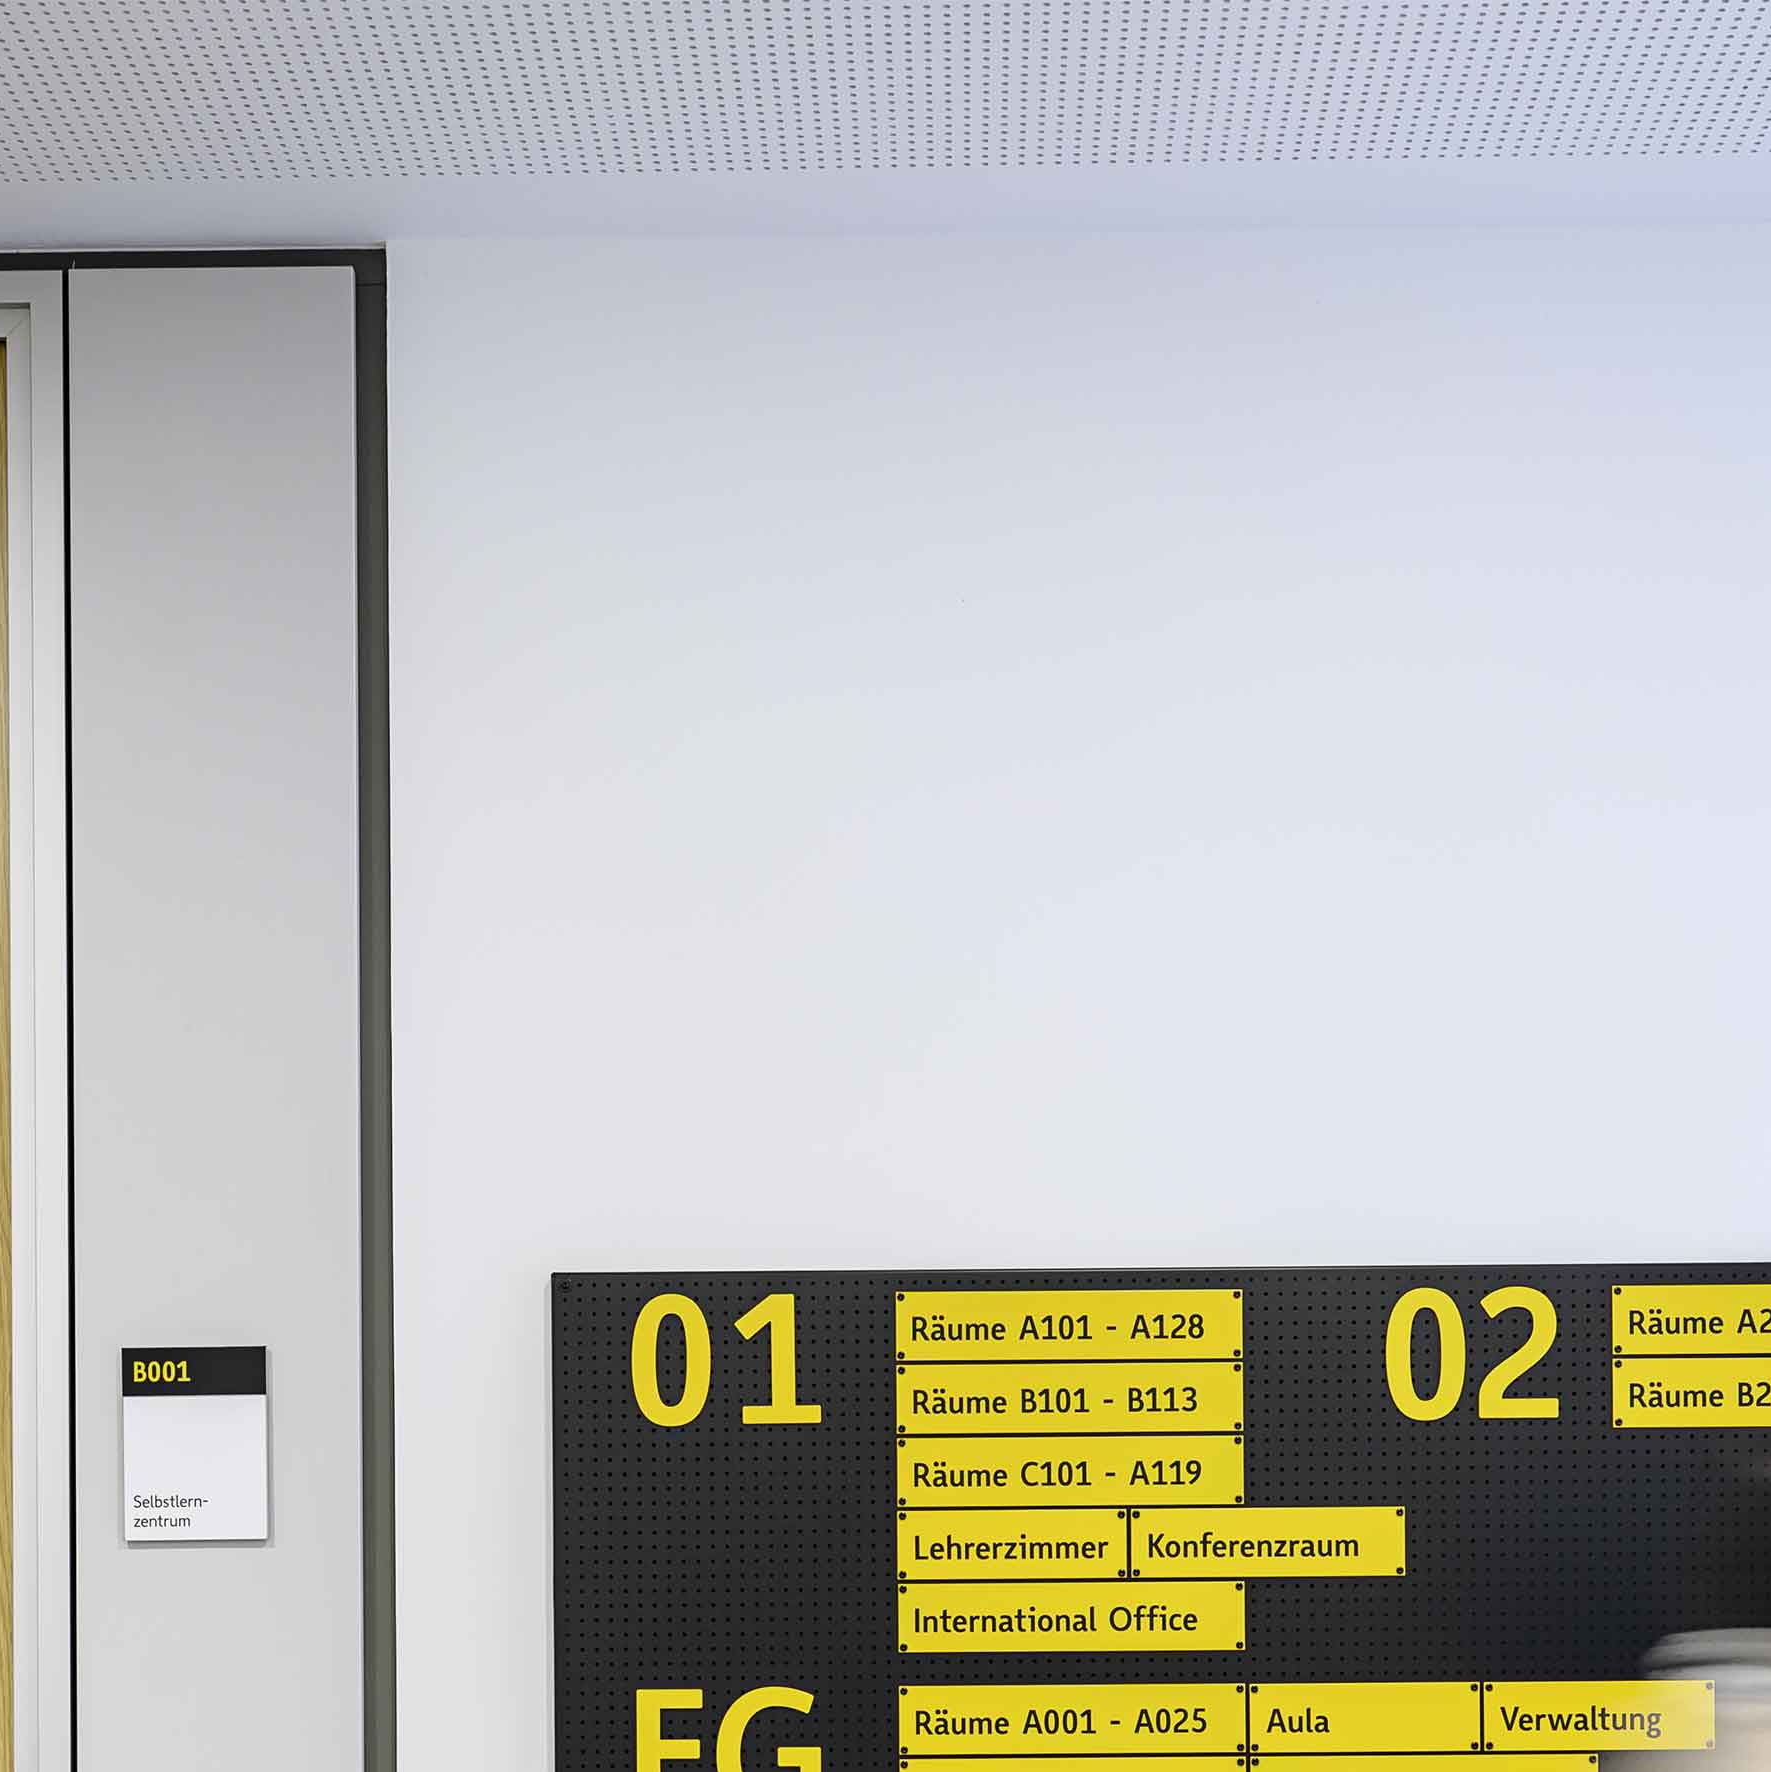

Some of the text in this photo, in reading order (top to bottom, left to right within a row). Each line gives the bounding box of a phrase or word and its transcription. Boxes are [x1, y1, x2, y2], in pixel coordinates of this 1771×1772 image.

[911, 1314, 1007, 1342] Räume
[1019, 1314, 1093, 1341] A101
[1130, 1313, 1205, 1340] A128
[1629, 1308, 1724, 1335] Räume
[631, 1293, 822, 1427] 01
[1385, 1286, 1560, 1422] 02
[133, 1360, 191, 1383] B001
[912, 1388, 1008, 1415] Räume
[1020, 1387, 1090, 1414] B101
[1128, 1386, 1198, 1413] B113
[1629, 1381, 1724, 1408] Räume
[913, 1460, 1008, 1488] Räume
[1020, 1460, 1093, 1487] C101
[1129, 1459, 1202, 1486] A119
[133, 1494, 209, 1509] Selbstlern-
[133, 1515, 191, 1528] zentrum
[914, 1533, 1109, 1561] Lehrerzimmer
[1148, 1531, 1359, 1559] Konferenzraum
[914, 1604, 1198, 1633] International Office
[915, 1708, 1010, 1736] Räume
[1022, 1708, 1097, 1735] A001
[1134, 1707, 1207, 1734] A025
[1266, 1707, 1330, 1734] Aula
[1499, 1704, 1661, 1739] Verwaltung
